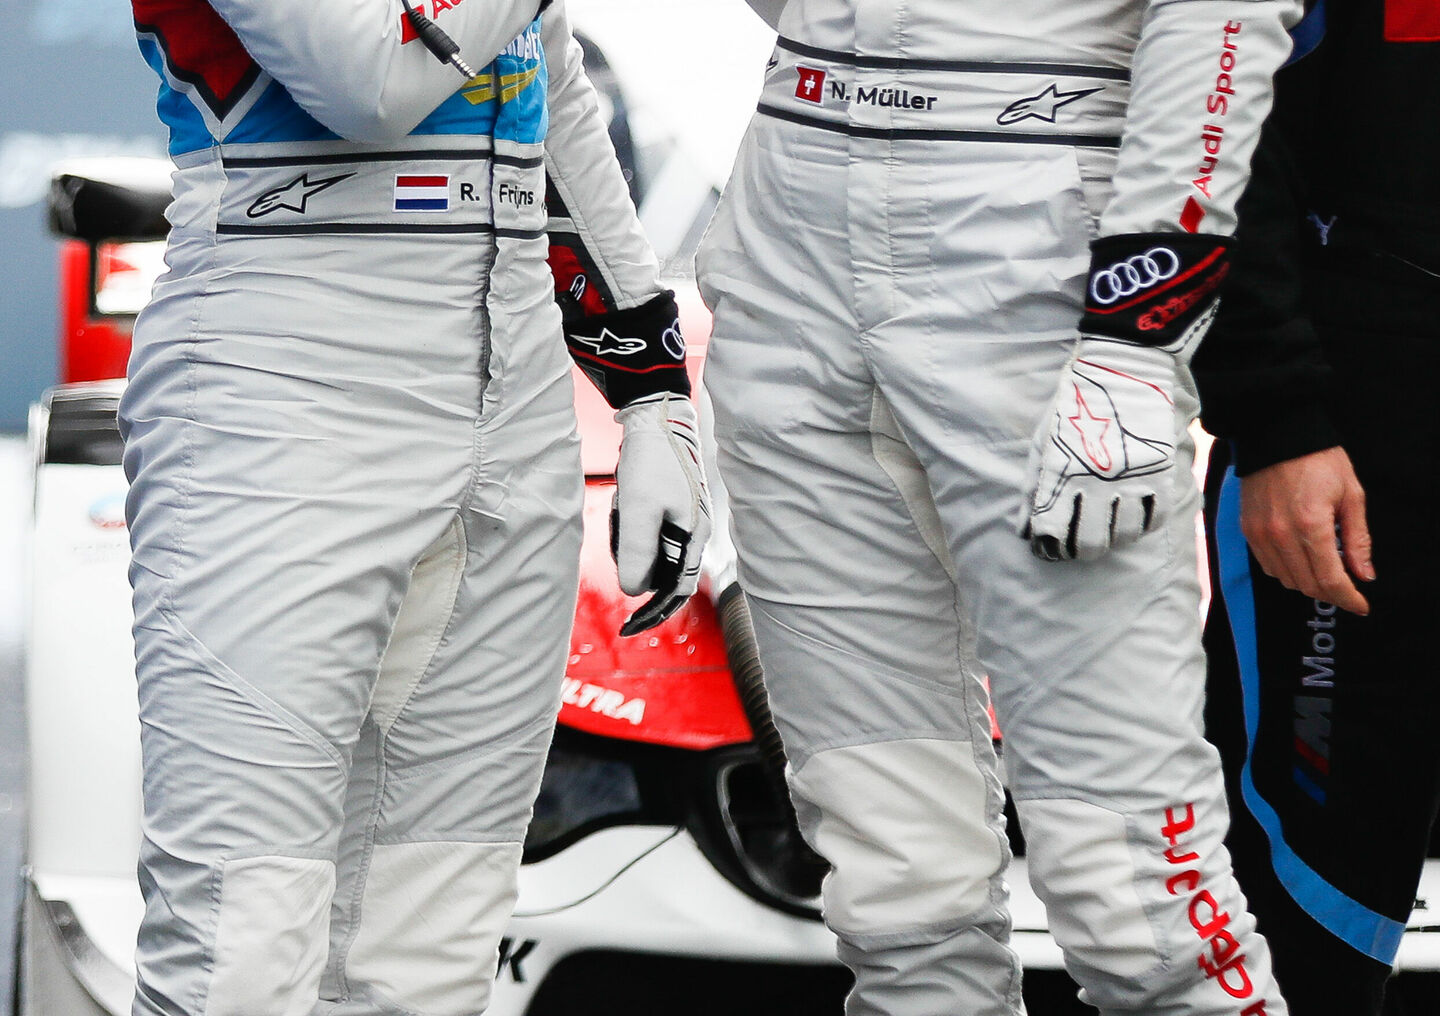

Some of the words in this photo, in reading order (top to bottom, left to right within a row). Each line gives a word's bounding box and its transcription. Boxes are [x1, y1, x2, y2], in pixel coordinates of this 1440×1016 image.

[1207, 19, 1242, 116] Sport
[831, 81, 851, 101] N.
[856, 86, 938, 111] Müller
[1192, 124, 1224, 199] Audi
[460, 182, 481, 202] R.
[559, 676, 647, 726] LTRA
